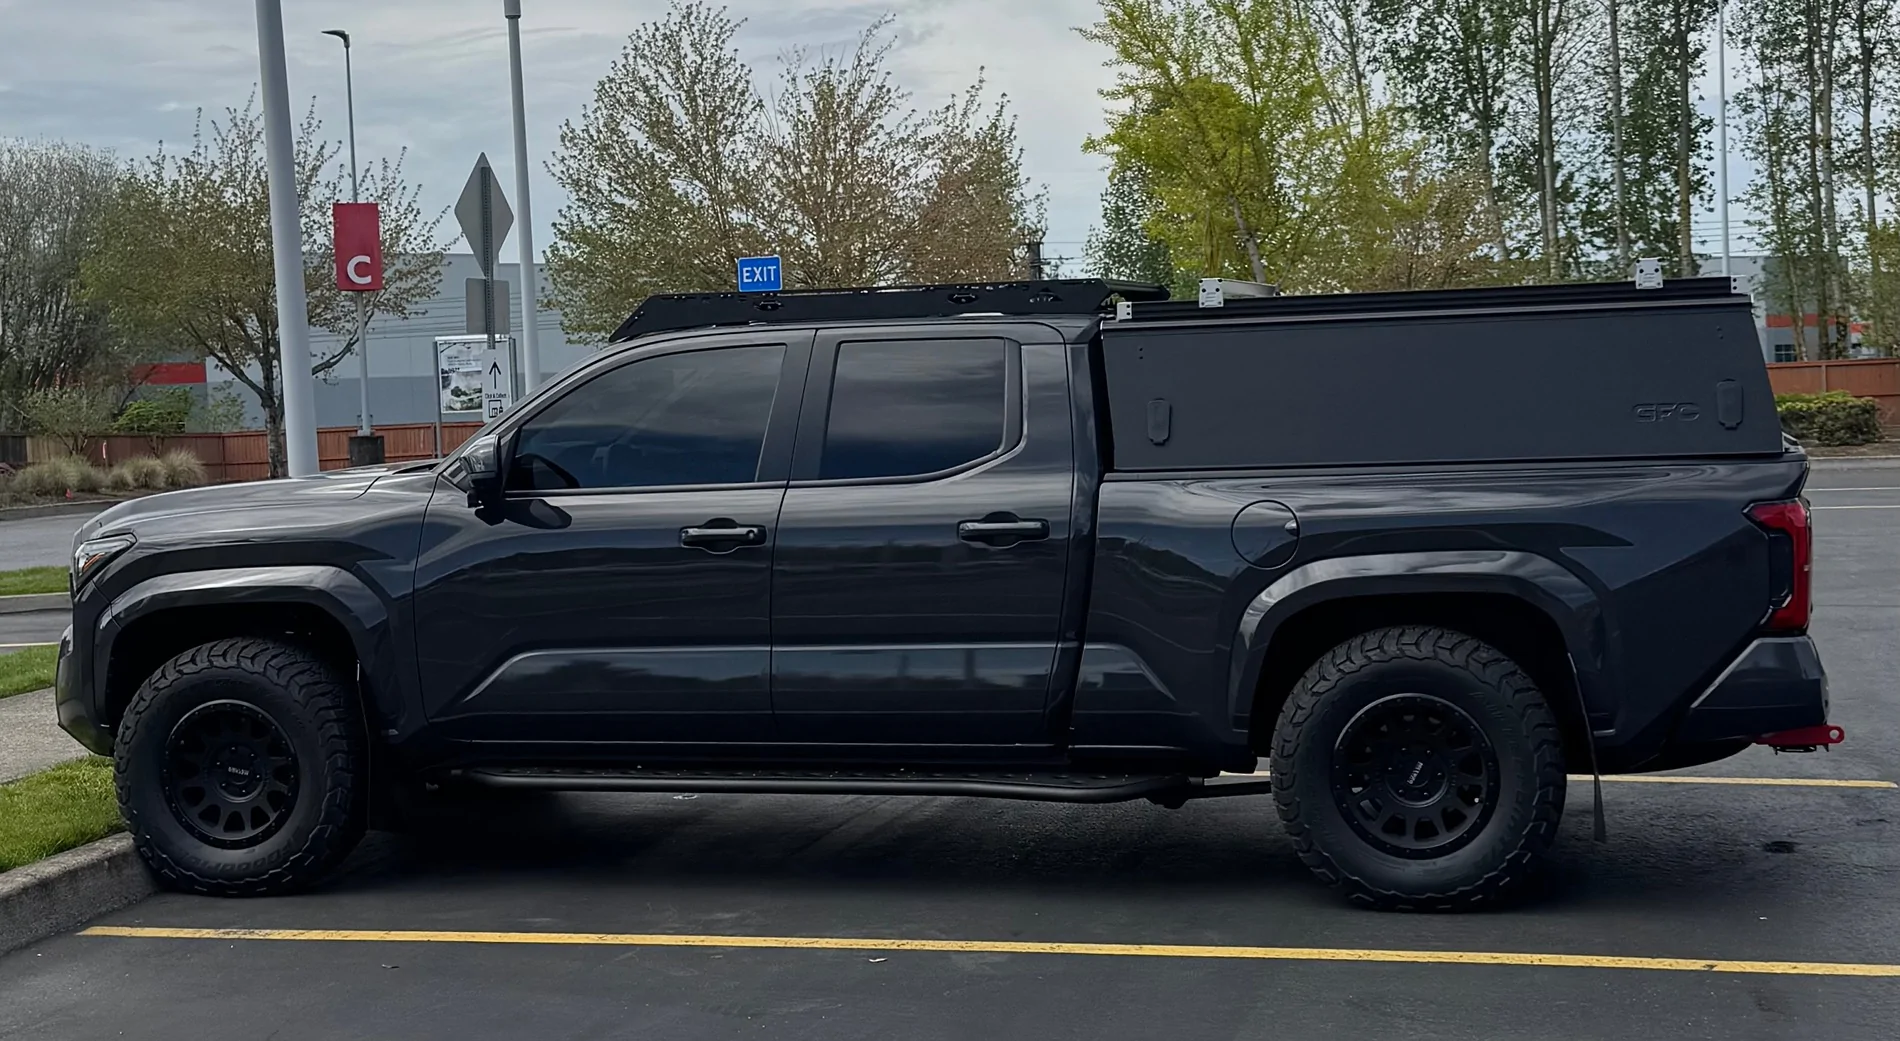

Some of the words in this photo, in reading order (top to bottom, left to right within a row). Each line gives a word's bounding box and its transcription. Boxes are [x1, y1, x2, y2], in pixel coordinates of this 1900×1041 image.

[346, 255, 372, 284] C
[742, 265, 777, 283] EXIT
[1632, 402, 1700, 422] GFC
